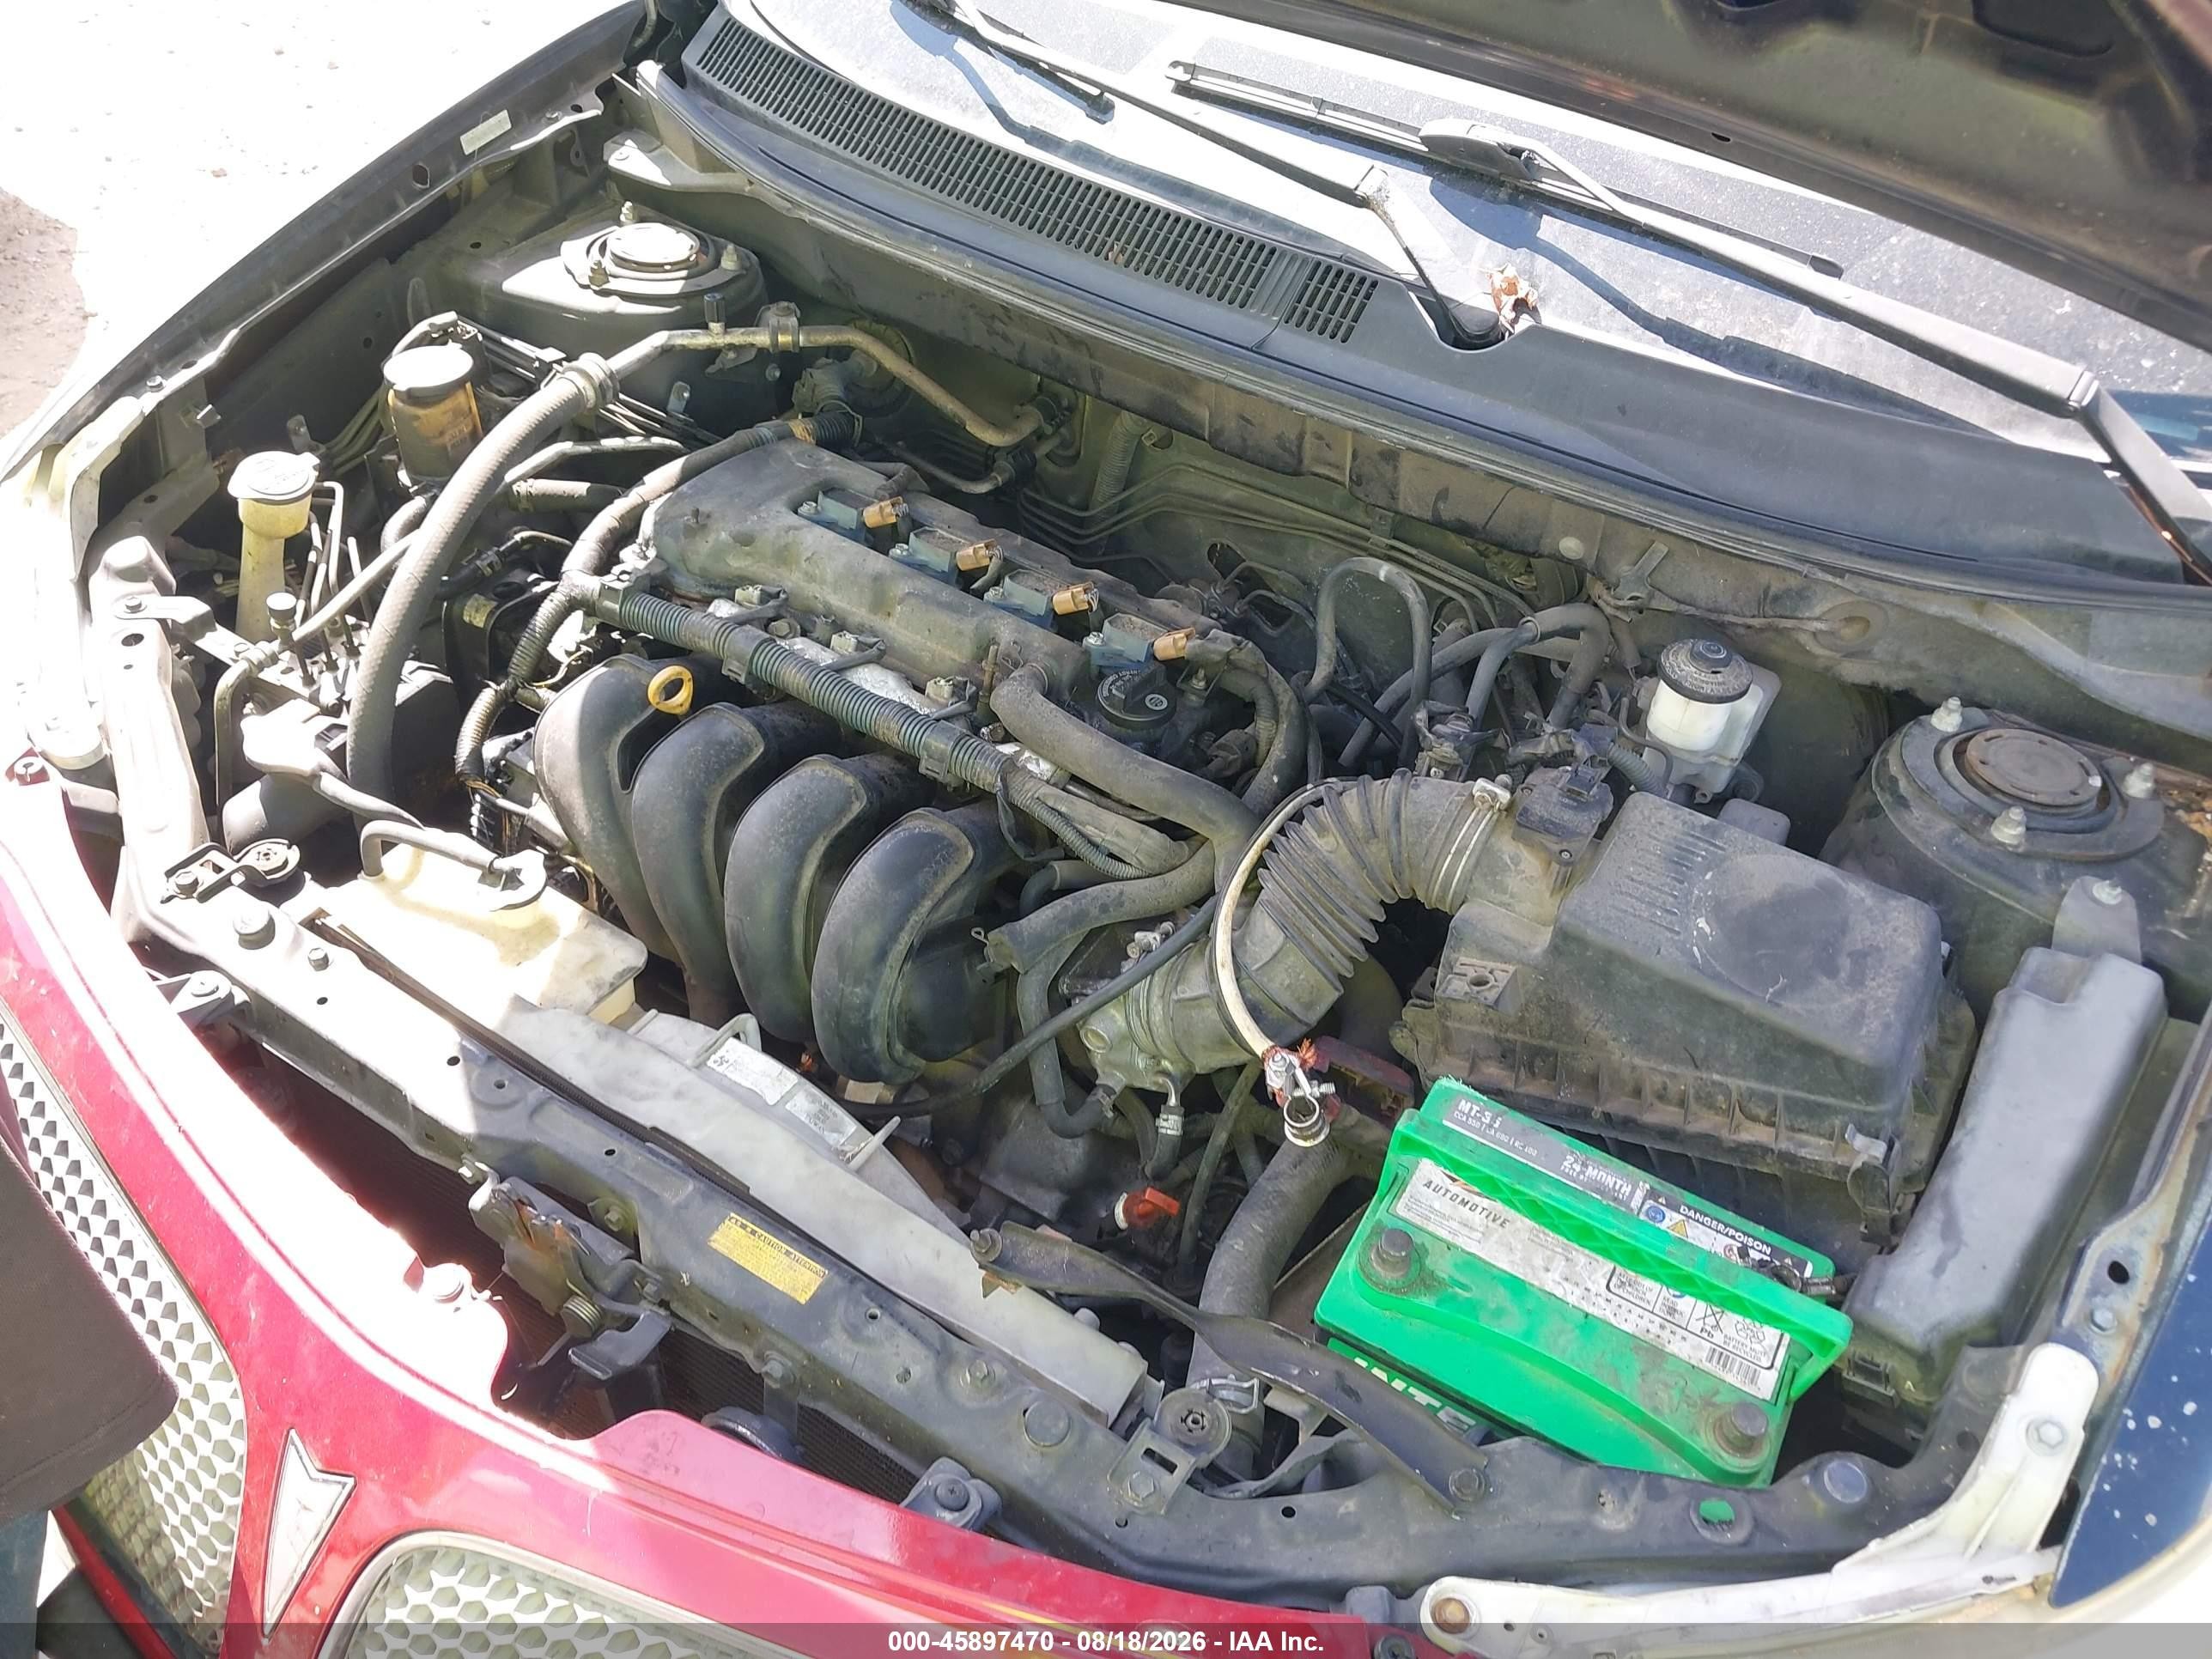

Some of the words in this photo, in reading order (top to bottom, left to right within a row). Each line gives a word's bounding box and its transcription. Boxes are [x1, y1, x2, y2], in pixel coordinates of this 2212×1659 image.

[1422, 1179, 1510, 1229] AUTOMOTIVE
[1680, 1205, 1772, 1255] DANGER/POISON
[1699, 1327, 1714, 1339] Pb
